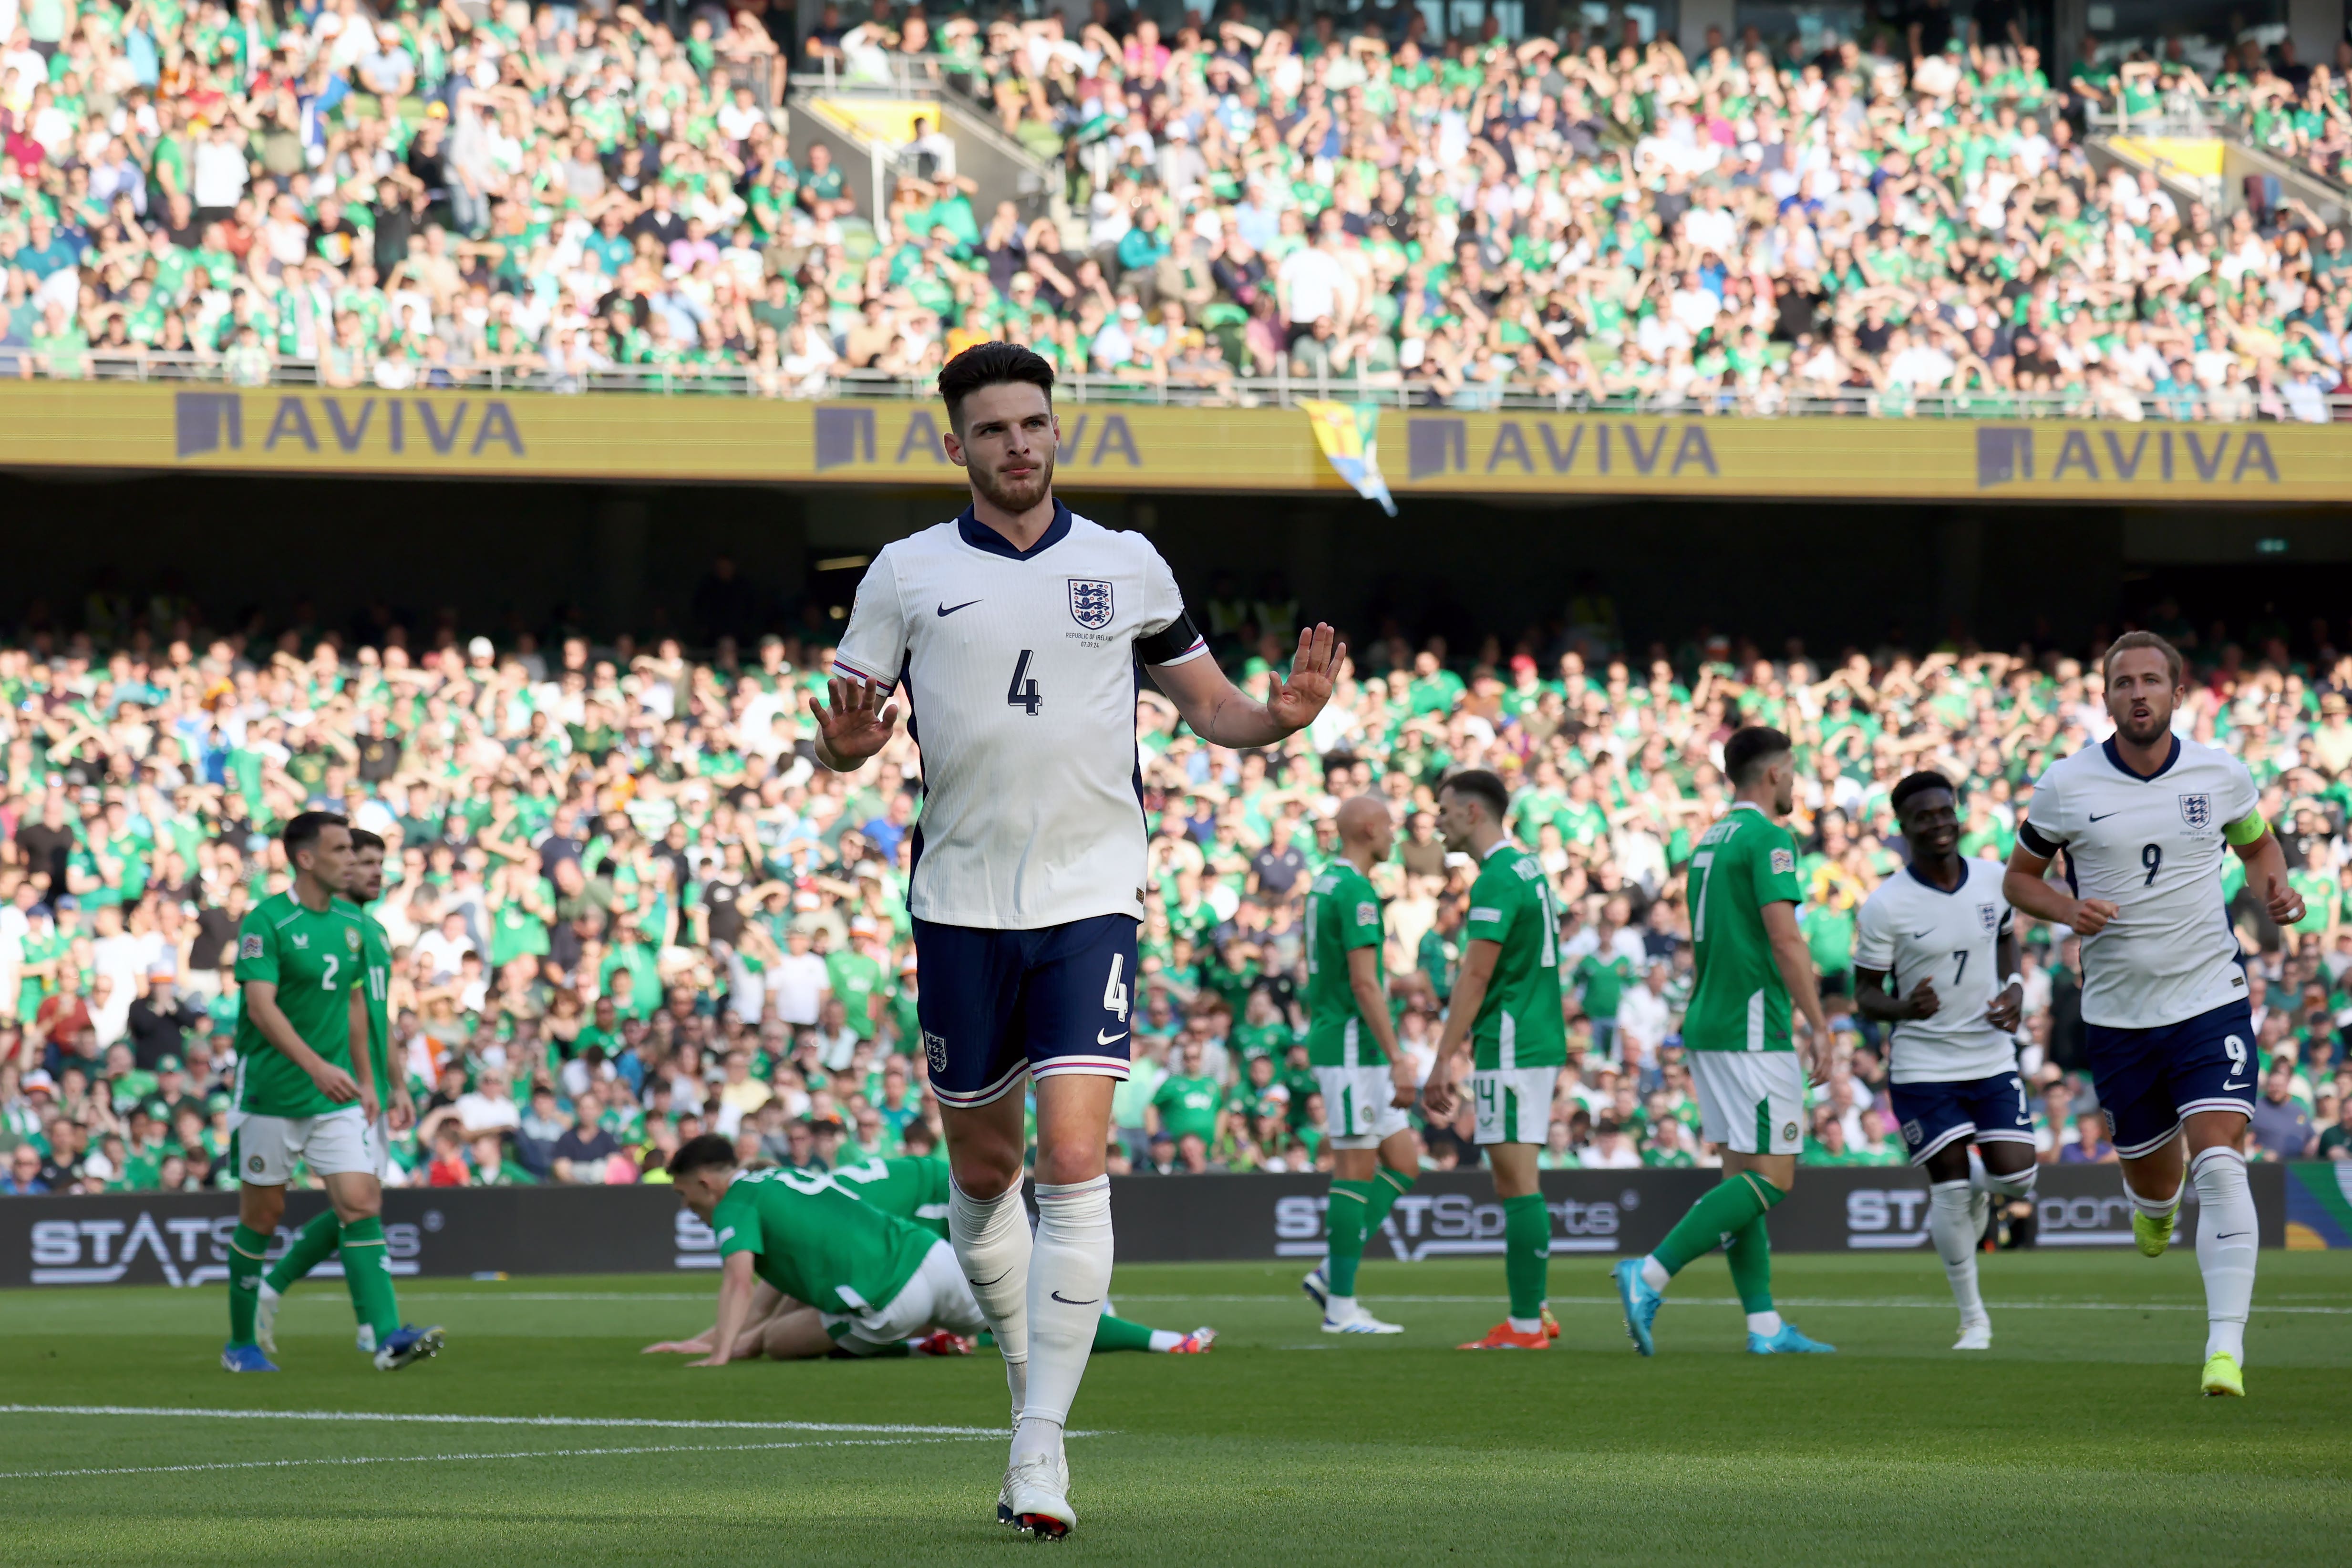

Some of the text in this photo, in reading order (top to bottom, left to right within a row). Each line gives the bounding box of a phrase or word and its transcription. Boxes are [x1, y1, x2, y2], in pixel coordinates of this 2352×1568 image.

[263, 395, 527, 456] AVIVA
[1485, 421, 1720, 476] AVIVA
[2052, 429, 2281, 483] AVIVA
[1007, 649, 1042, 716] 4
[2141, 843, 2164, 887] 9
[1692, 851, 1715, 942] 7
[321, 953, 340, 991] 2
[368, 965, 386, 1002] 11
[1104, 953, 1129, 1022] 4
[1952, 950, 1969, 986] 7
[2223, 1034, 2248, 1076] 9
